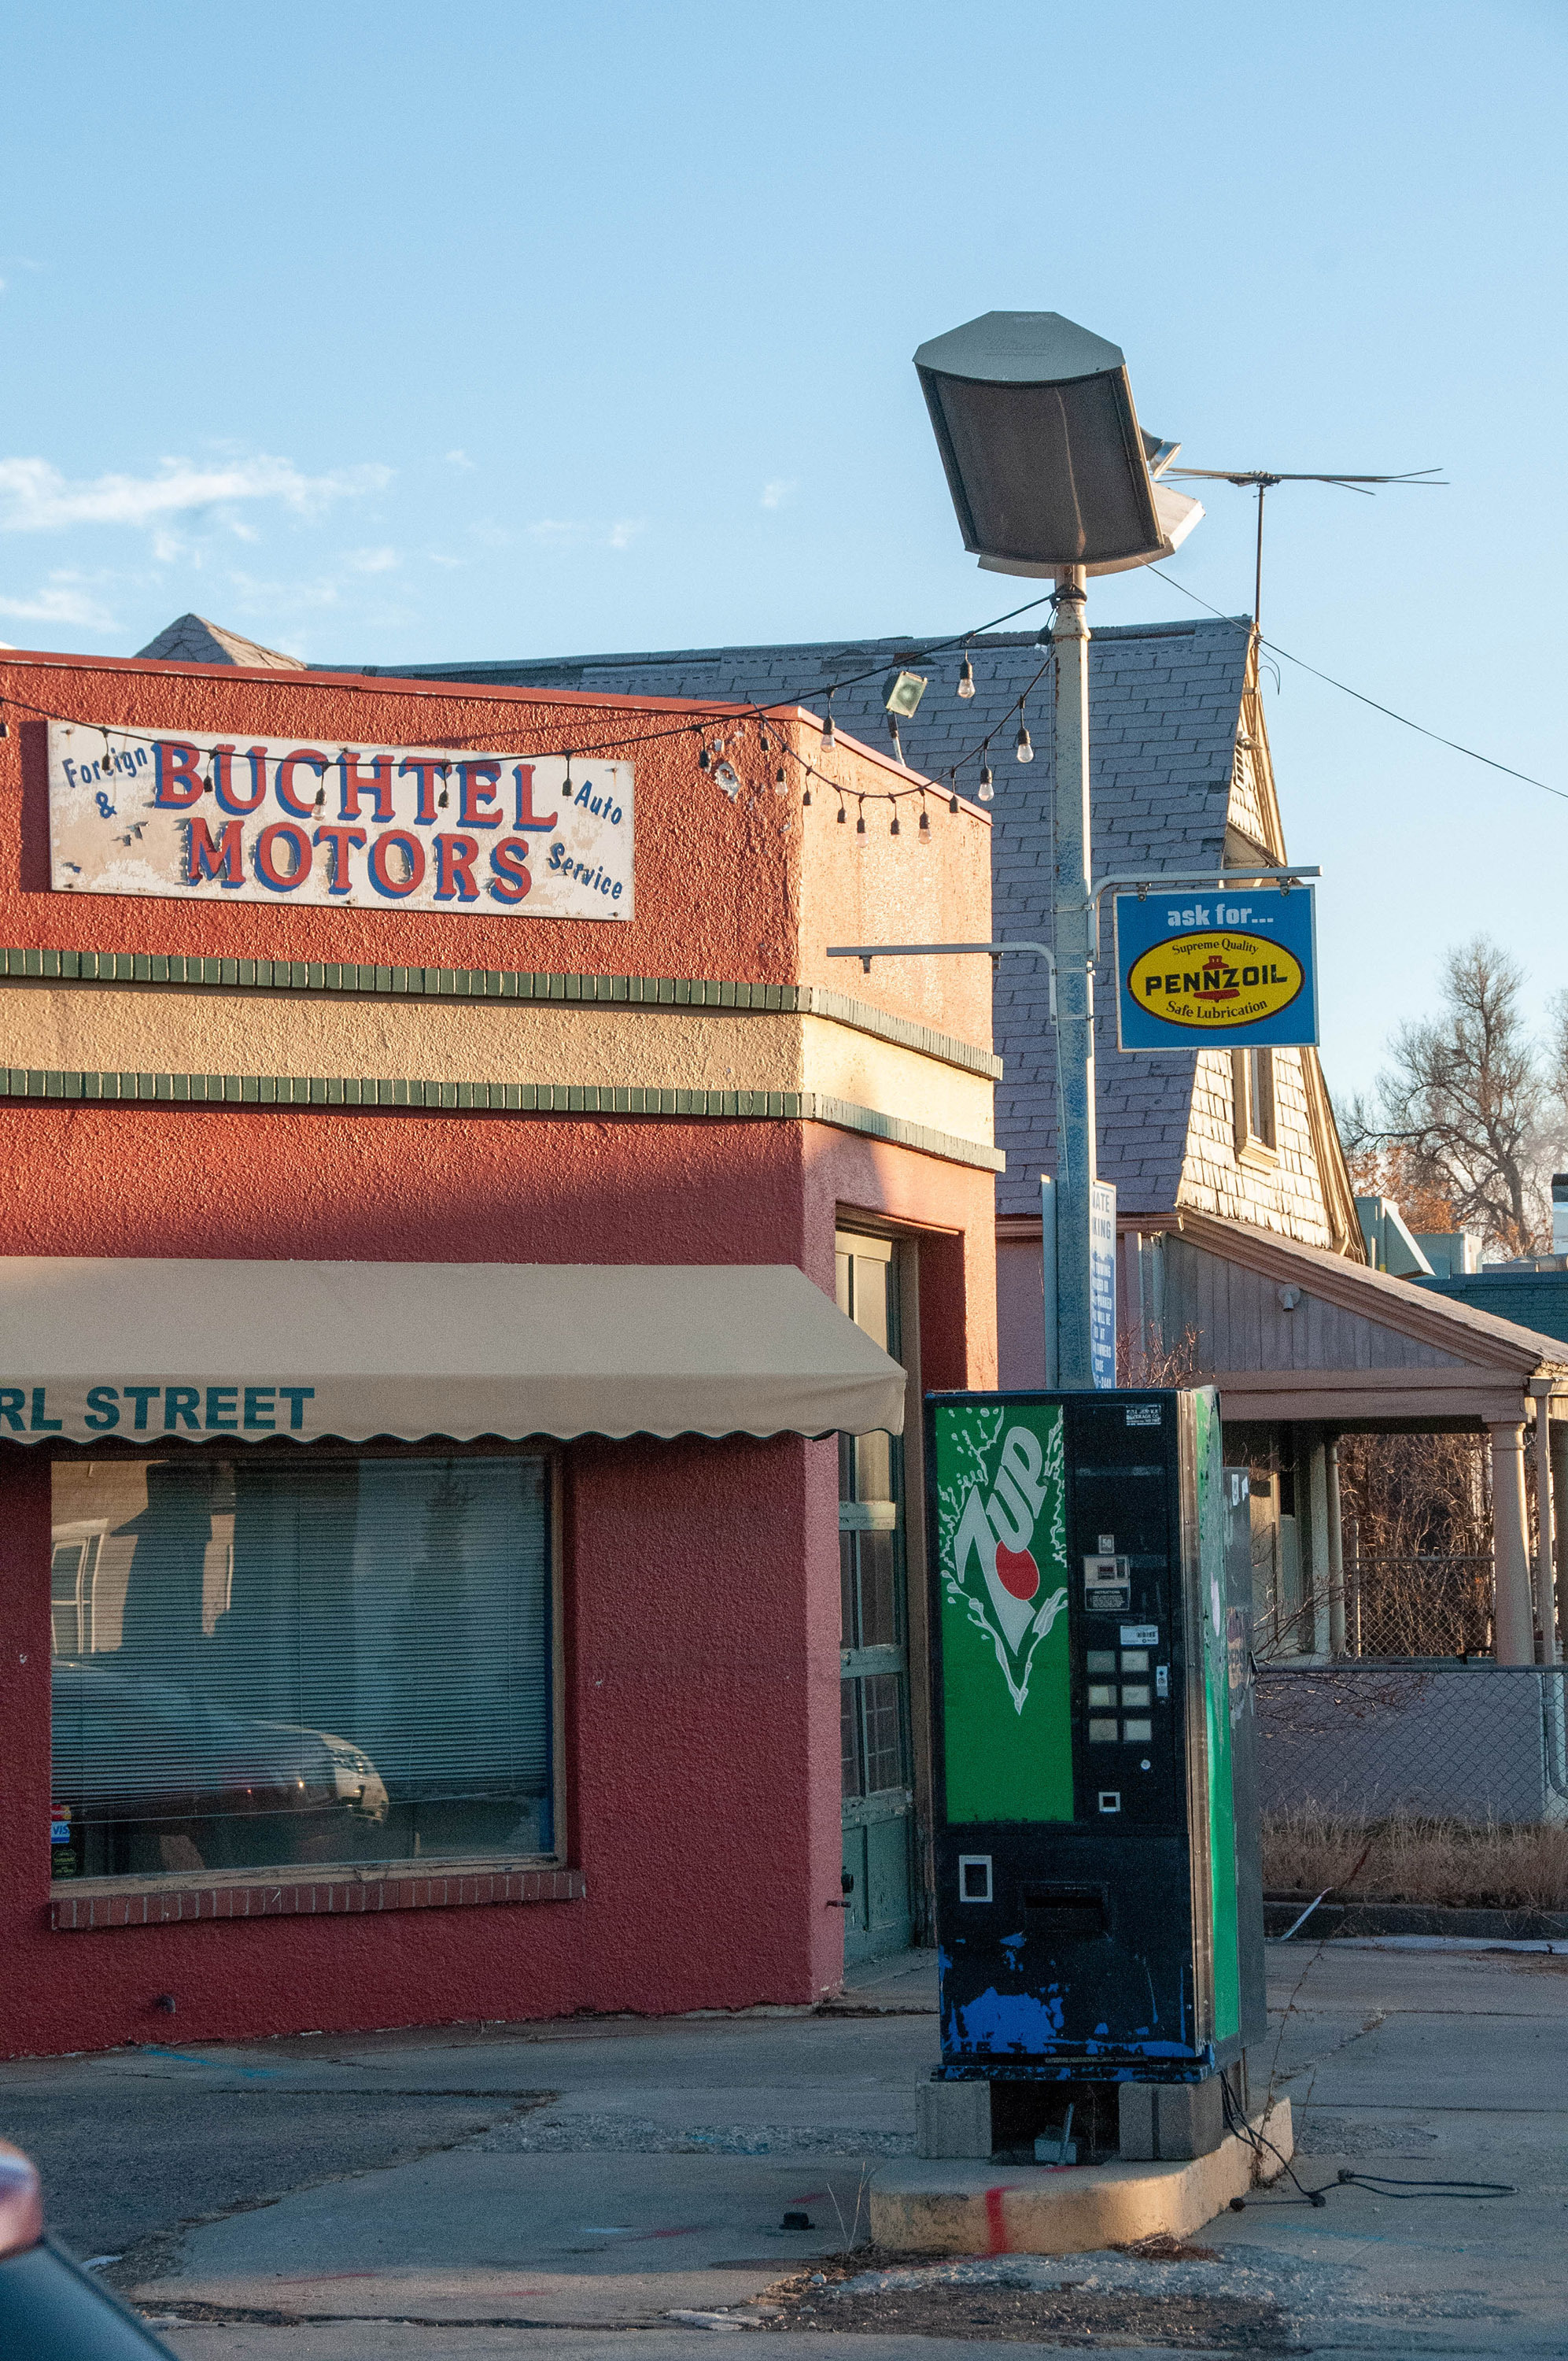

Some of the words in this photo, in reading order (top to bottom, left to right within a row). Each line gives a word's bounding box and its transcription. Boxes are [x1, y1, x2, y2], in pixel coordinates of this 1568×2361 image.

[62, 747, 148, 788] Forign
[150, 739, 558, 832] BUCHTEL
[95, 791, 117, 818] &
[574, 779, 622, 825] Auto
[186, 818, 532, 904] MOTORS
[548, 842, 622, 900] Service
[1168, 904, 1210, 926] ask
[1216, 903, 1274, 925] for...
[1172, 941, 1219, 955] Supreme
[1221, 937, 1259, 955] Quality
[1146, 964, 1288, 996] PENNZOIL
[1166, 1000, 1194, 1018] Safe
[1197, 1000, 1267, 1019] Lubrication
[84, 1386, 315, 1431] STREET
[53, 1825, 70, 1834] VIS
